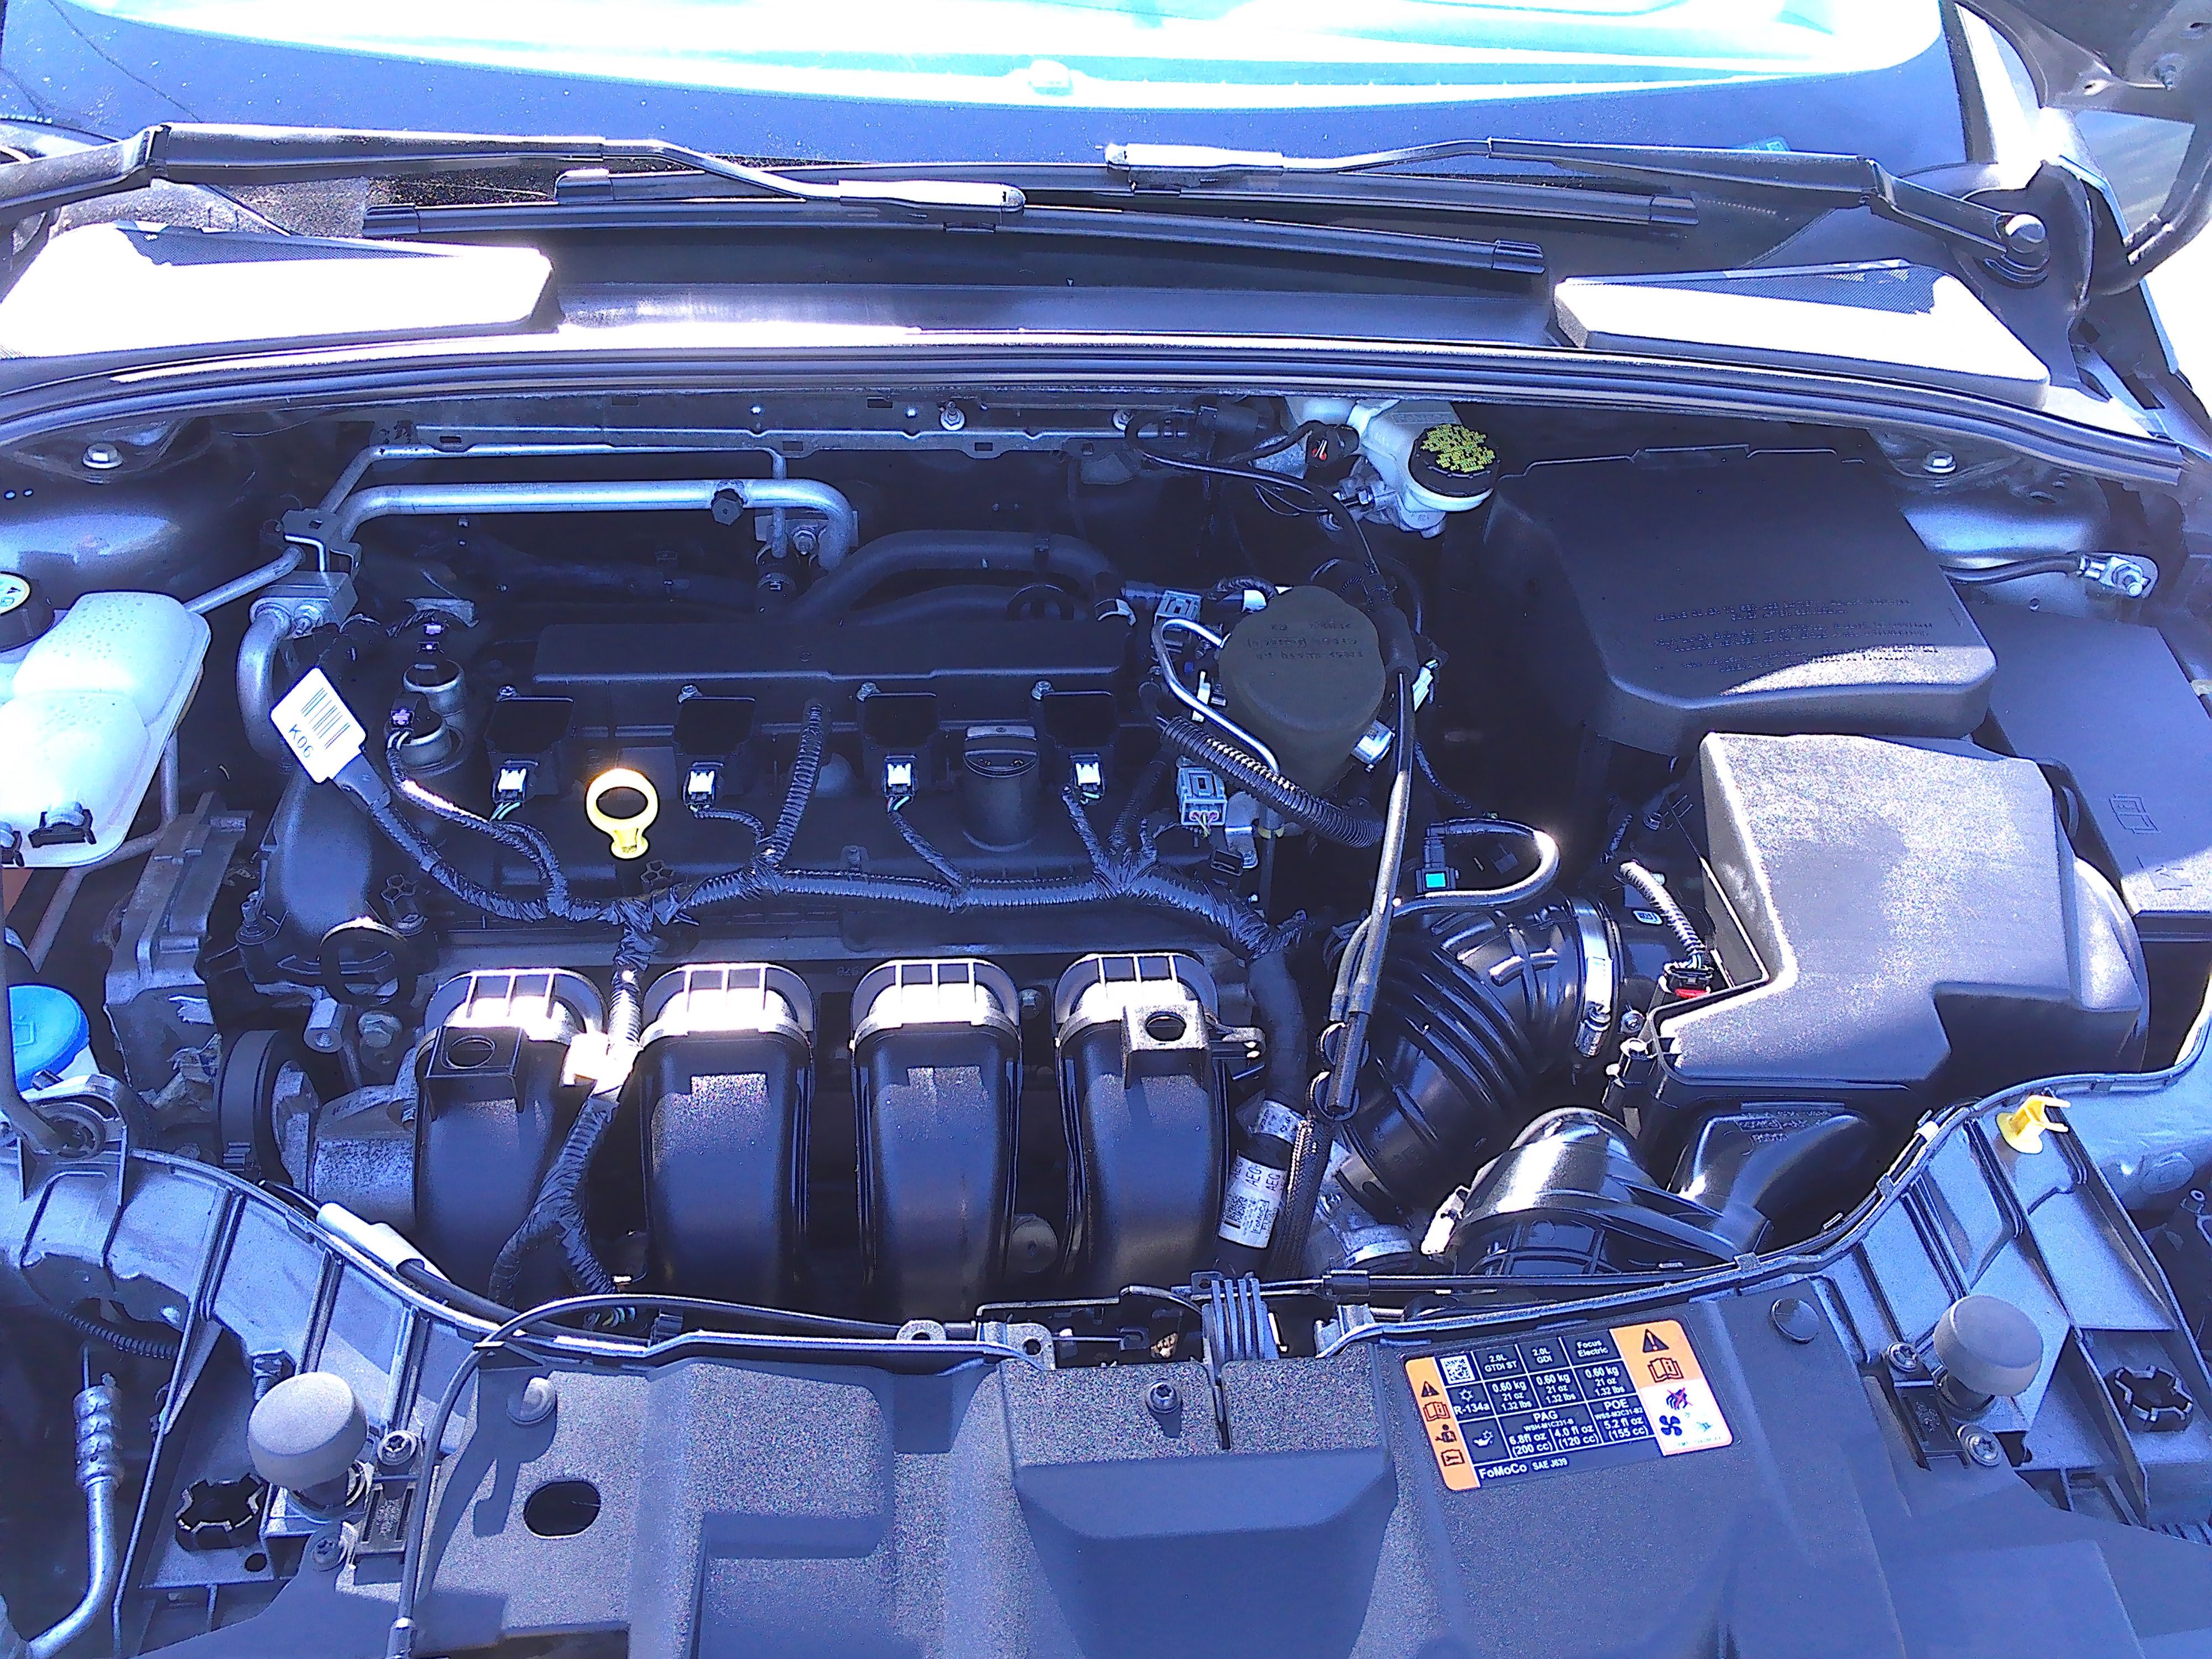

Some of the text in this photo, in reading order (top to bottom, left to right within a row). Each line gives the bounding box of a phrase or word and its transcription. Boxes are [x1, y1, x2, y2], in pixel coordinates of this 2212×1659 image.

[288, 724, 314, 758] K06
[1245, 1165, 1262, 1187] AEG
[1265, 1173, 1281, 1192] AEG
[1253, 1202, 1267, 1232] FoMoCo
[1577, 1340, 1602, 1349] Focus
[1532, 1347, 1551, 1356] 2.0L
[1577, 1347, 1609, 1357] Electric
[1489, 1354, 1507, 1363] 2.0L
[1536, 1355, 1553, 1364] GDI
[1484, 1360, 1517, 1372] GTDI ST
[1584, 1365, 1620, 1379] 0.60 kg
[1536, 1373, 1571, 1385] 0.60 kg
[1595, 1378, 1605, 1386] 21
[1492, 1380, 1527, 1393] 0.60 kg
[1546, 1385, 1556, 1394] 21
[1594, 1385, 1625, 1396] 1.32 lbs
[1502, 1392, 1512, 1401] 21
[1545, 1395, 1563, 1404] 1.32
[1453, 1402, 1490, 1415] R-134a
[1501, 1402, 1518, 1411] 1.32
[1604, 1398, 1629, 1411] POE
[1533, 1410, 1558, 1422] PAG
[1604, 1420, 1620, 1430] 5.2
[1620, 1417, 1629, 1427] fl
[1533, 1433, 1547, 1441] oz
[1554, 1425, 1594, 1437] 4.0 fl oz
[1608, 1425, 1649, 1442] (155 cc)
[1558, 1433, 1599, 1449] (120 cc)
[1512, 1441, 1553, 1458] (200 cc)
[1478, 1458, 1568, 1479] FoMoCo SAE J639
